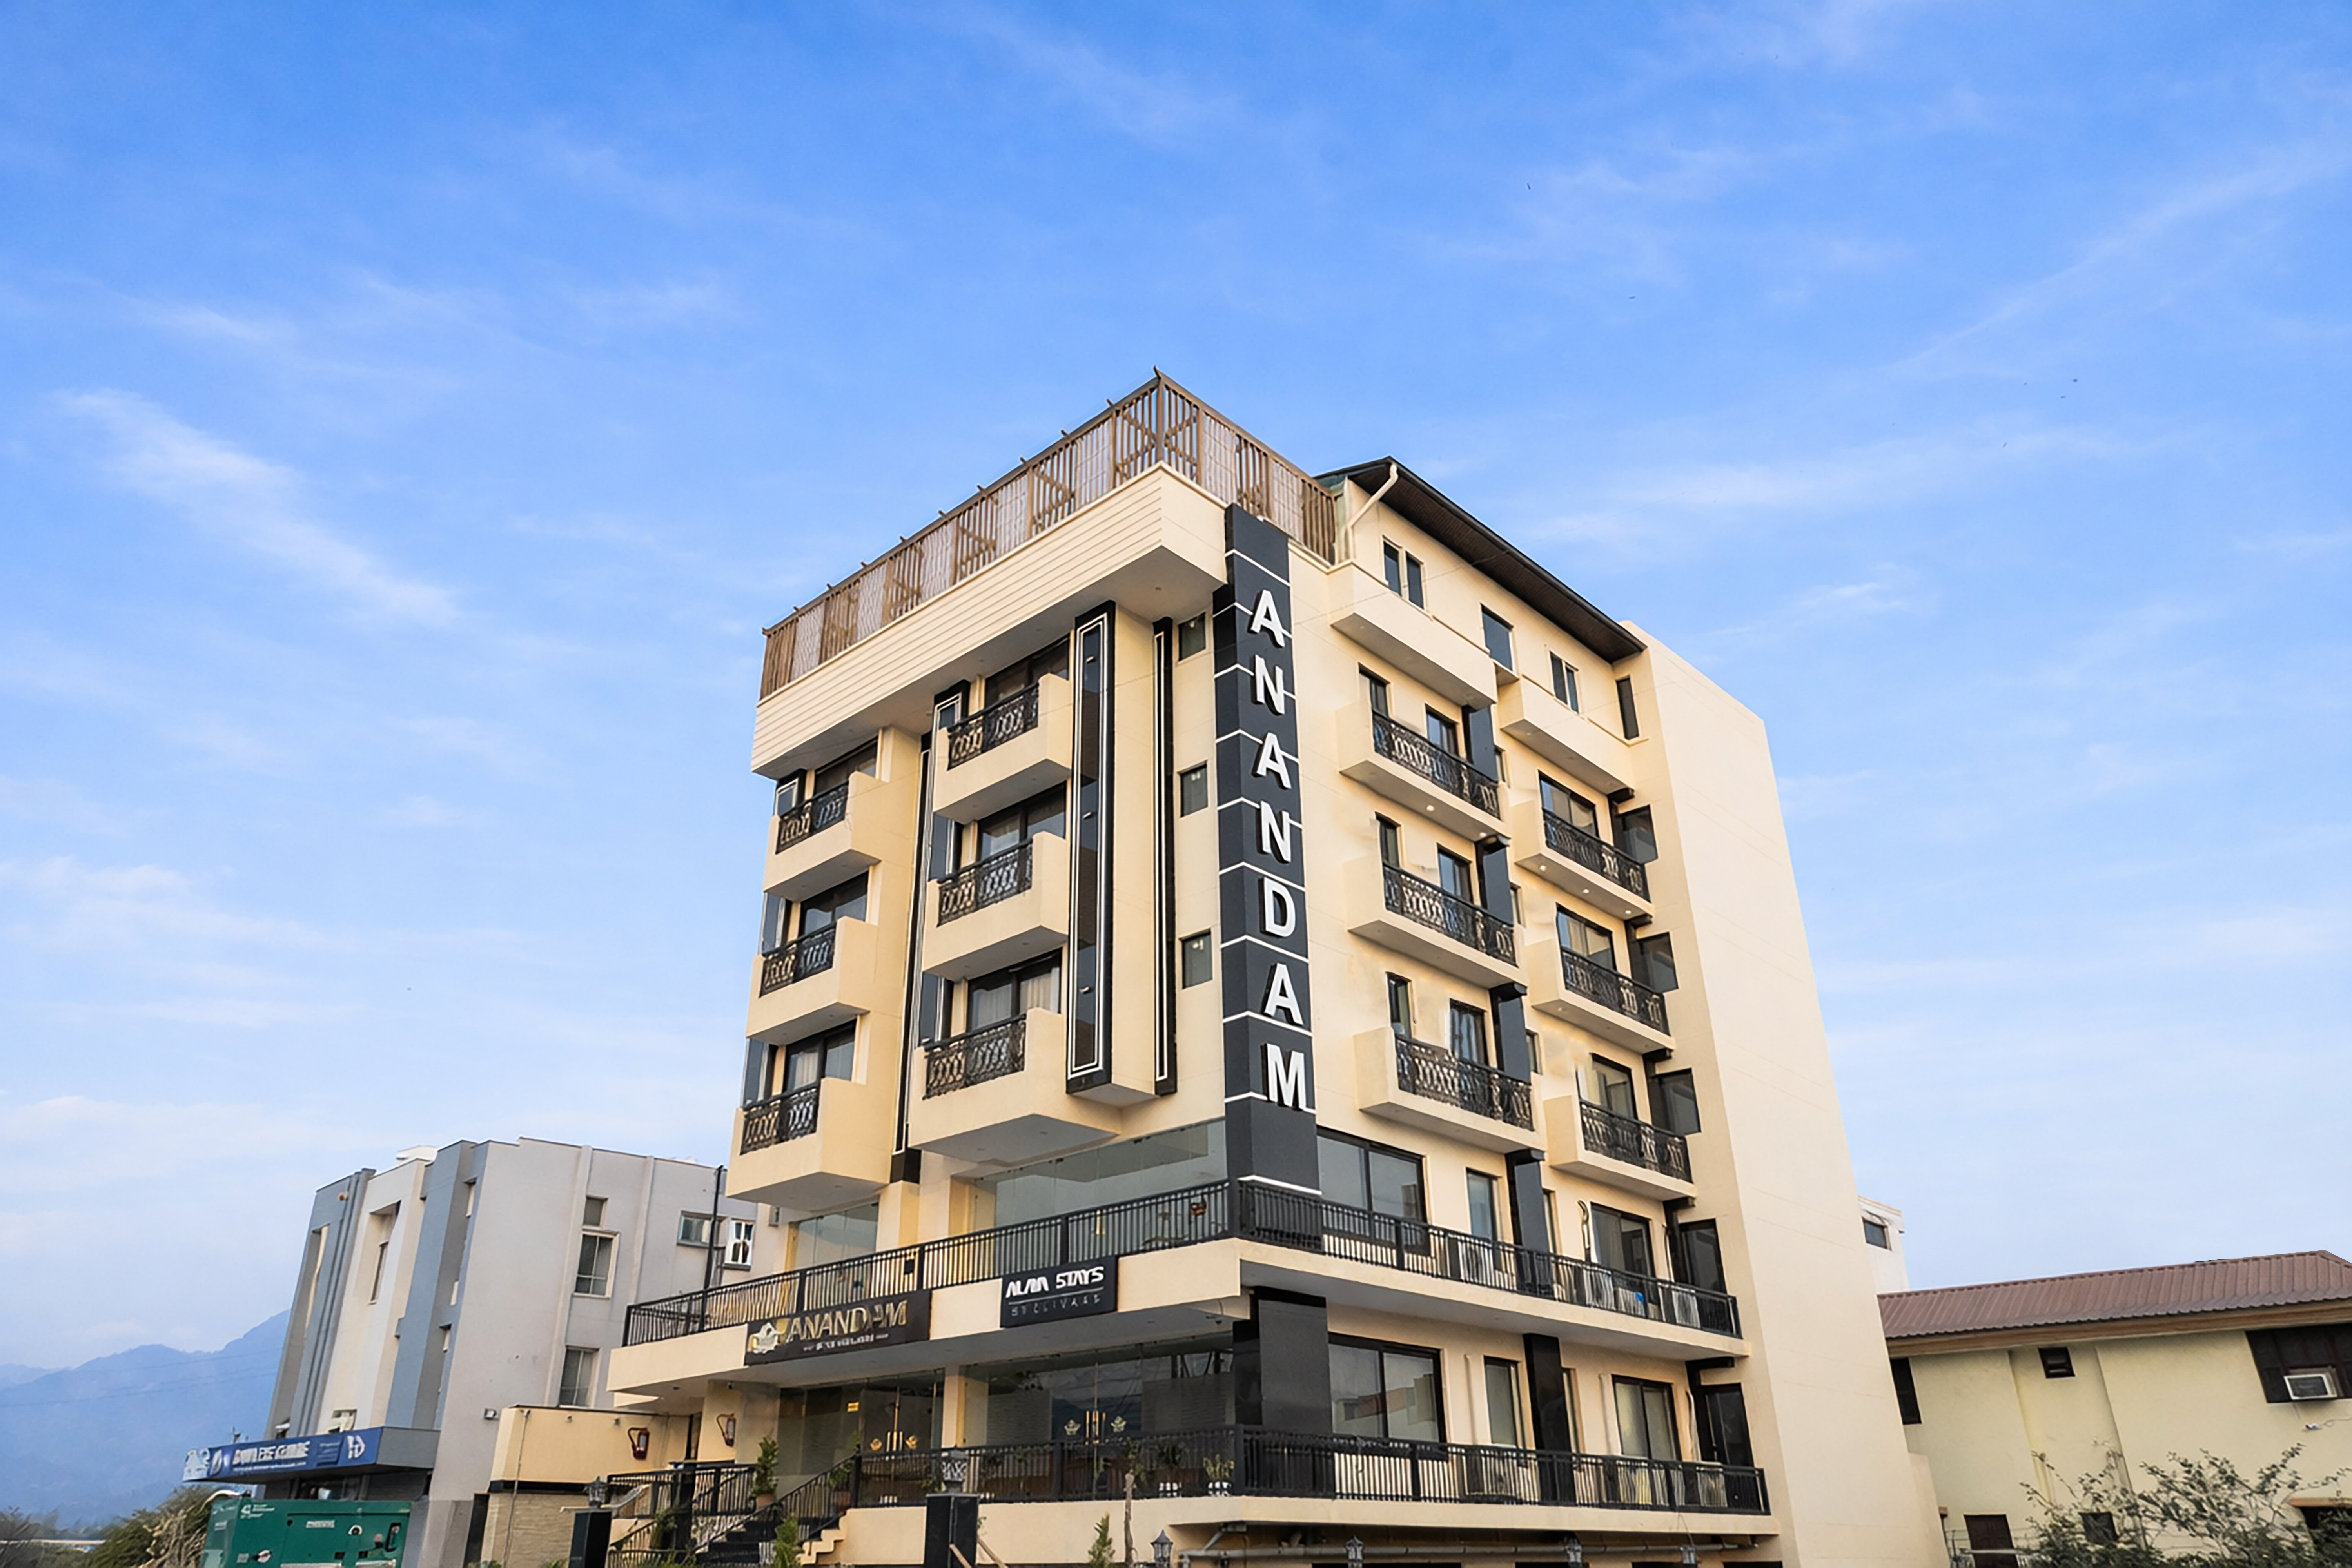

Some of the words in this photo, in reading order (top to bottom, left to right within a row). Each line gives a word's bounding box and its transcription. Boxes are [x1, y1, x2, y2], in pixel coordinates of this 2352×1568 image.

[1250, 589, 1306, 1109] ANANDAM
[1056, 1266, 1104, 1289] STAYS
[786, 1299, 907, 1343] ANANDAM
